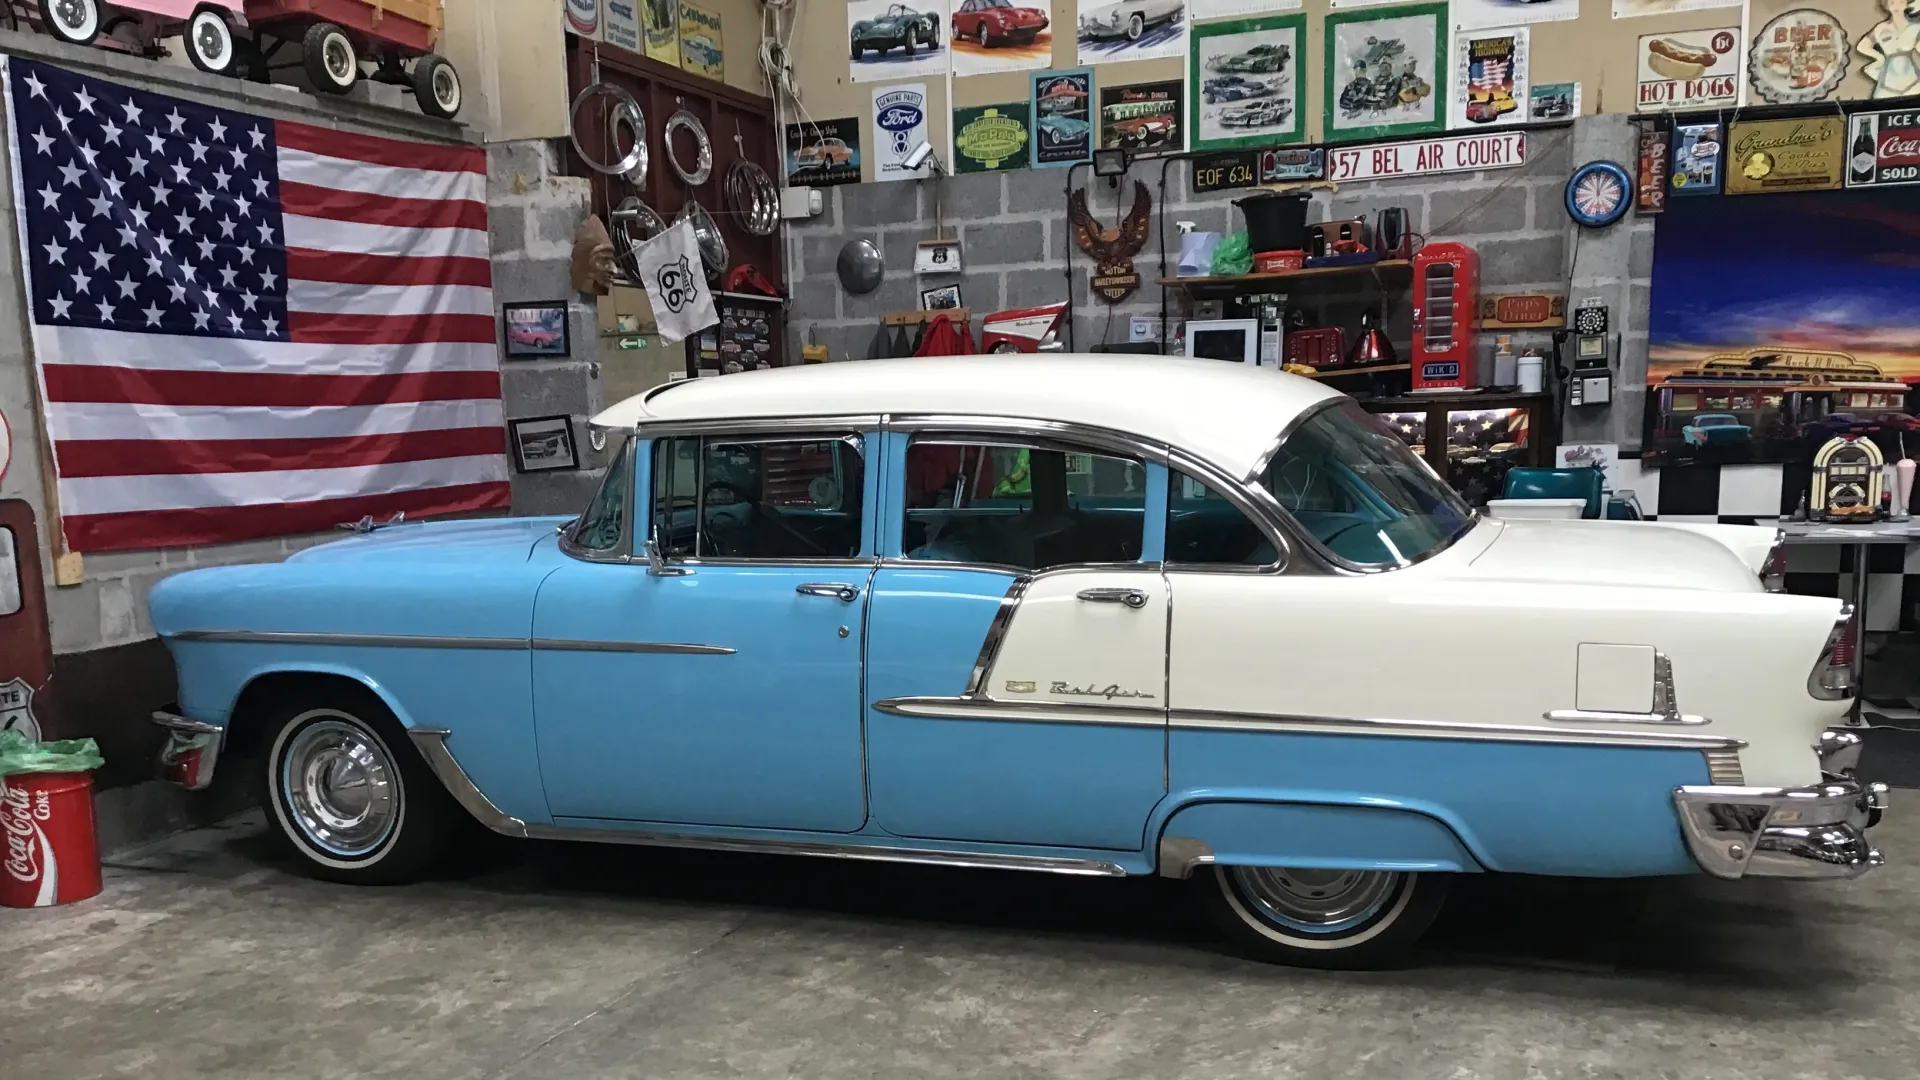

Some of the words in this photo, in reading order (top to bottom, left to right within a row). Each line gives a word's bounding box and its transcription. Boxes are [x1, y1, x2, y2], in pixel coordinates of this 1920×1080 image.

[1774, 24, 1832, 43] BEER
[1475, 47, 1509, 56] HIGHWAY
[1640, 82, 1677, 102] HOT
[1685, 77, 1734, 99] DOGS
[880, 94, 902, 106] GENUINE
[904, 94, 920, 102] PARTS
[882, 108, 918, 126] Ford
[1888, 114, 1912, 127] ICE
[1339, 152, 1361, 178] 57
[1372, 148, 1403, 175] BEL
[1416, 144, 1444, 170] AIR
[1456, 137, 1513, 167] COURT
[1197, 168, 1223, 186] EOF
[1229, 165, 1253, 182] 634
[1882, 167, 1917, 180] SOLD
[681, 263, 692, 293] ROUTE
[1105, 266, 1127, 275] MOTOR
[662, 270, 684, 307] 66
